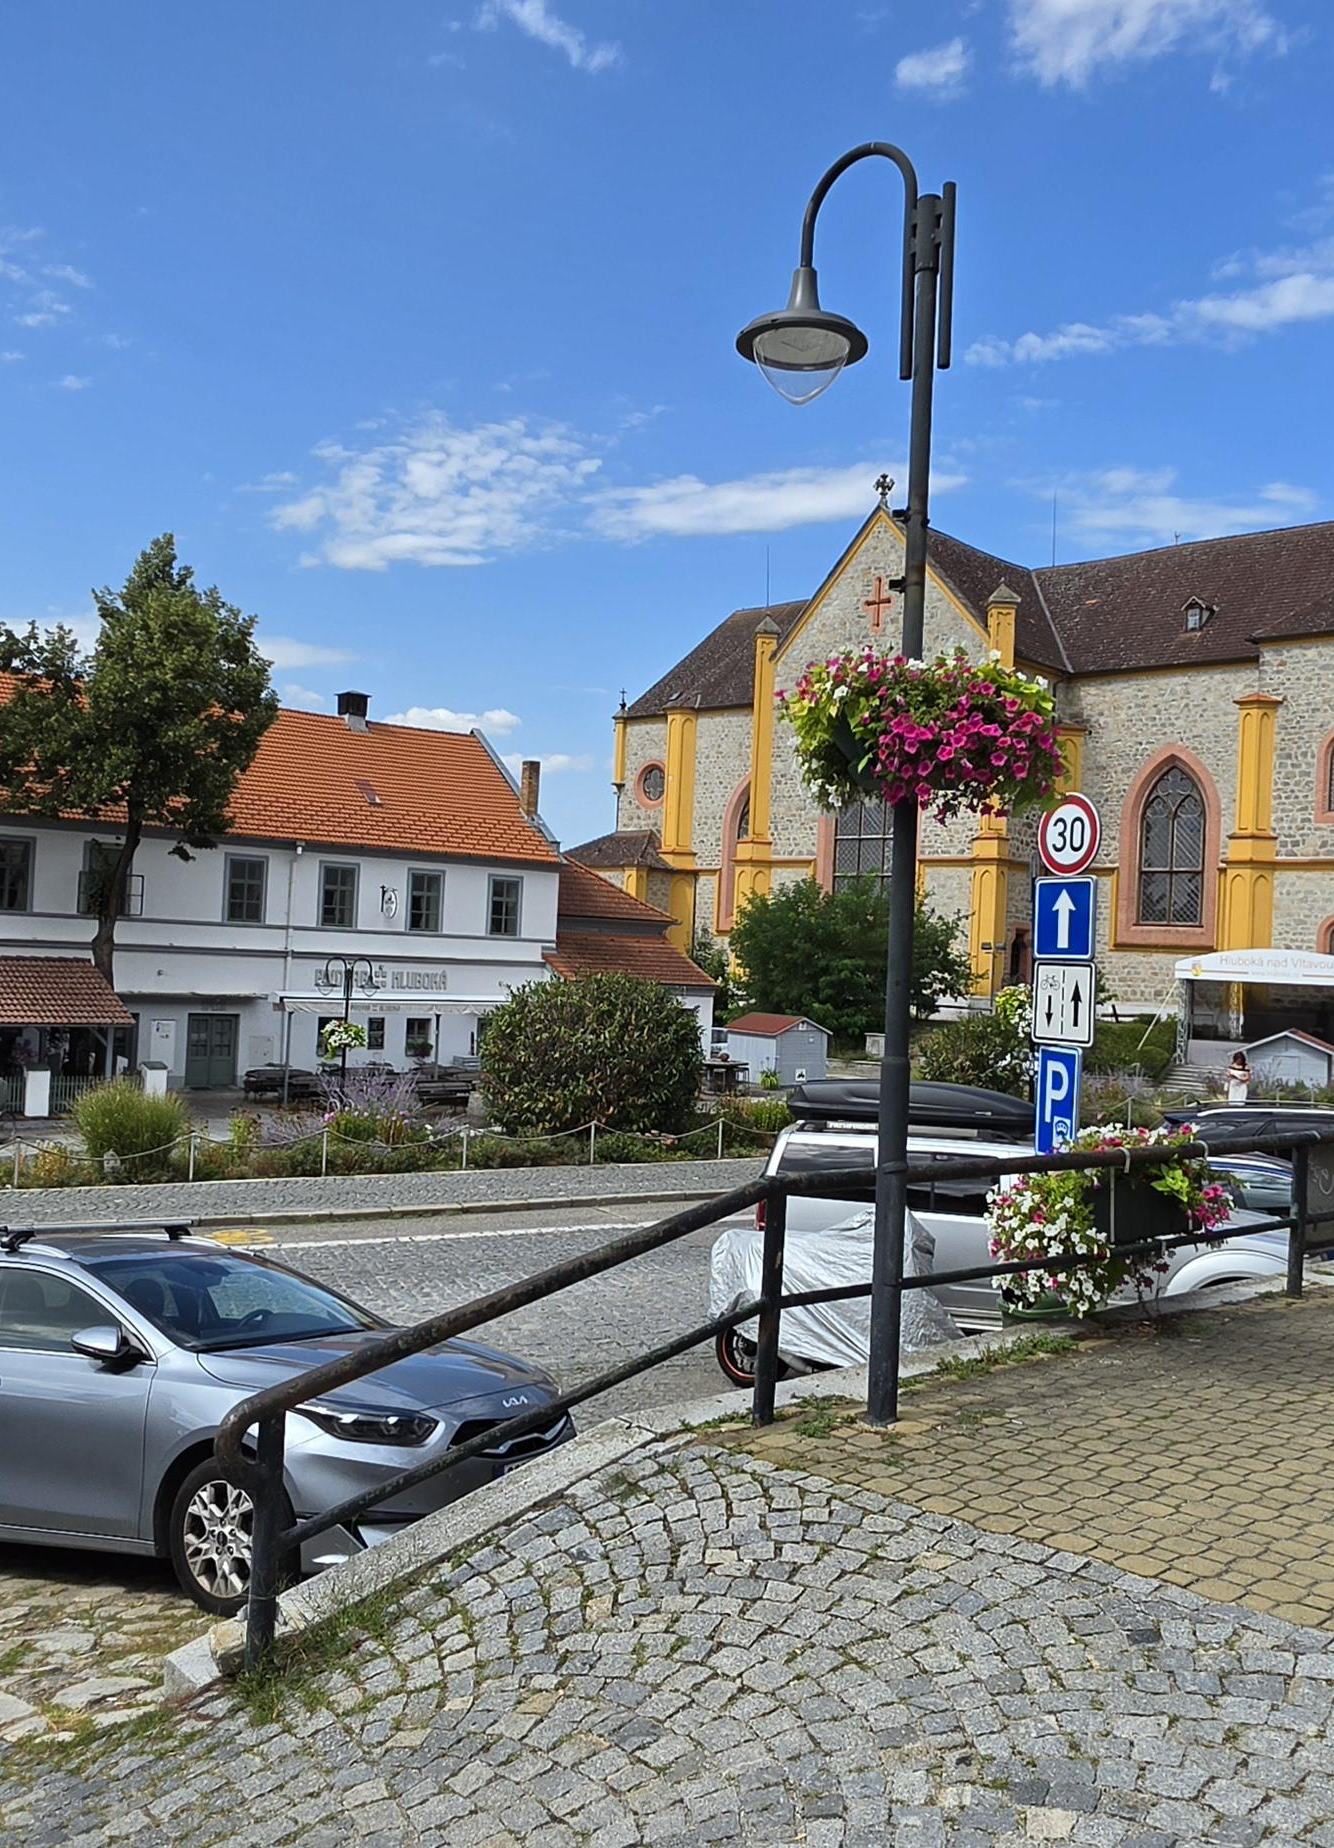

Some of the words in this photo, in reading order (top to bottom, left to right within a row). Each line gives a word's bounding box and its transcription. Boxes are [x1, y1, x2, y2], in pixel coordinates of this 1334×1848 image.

[1052, 816, 1085, 852] 30
[1219, 955, 1264, 967] Hluboká
[1267, 958, 1288, 968] nad
[1292, 958, 1334, 969] Vltavou
[1045, 1060, 1069, 1123] P
